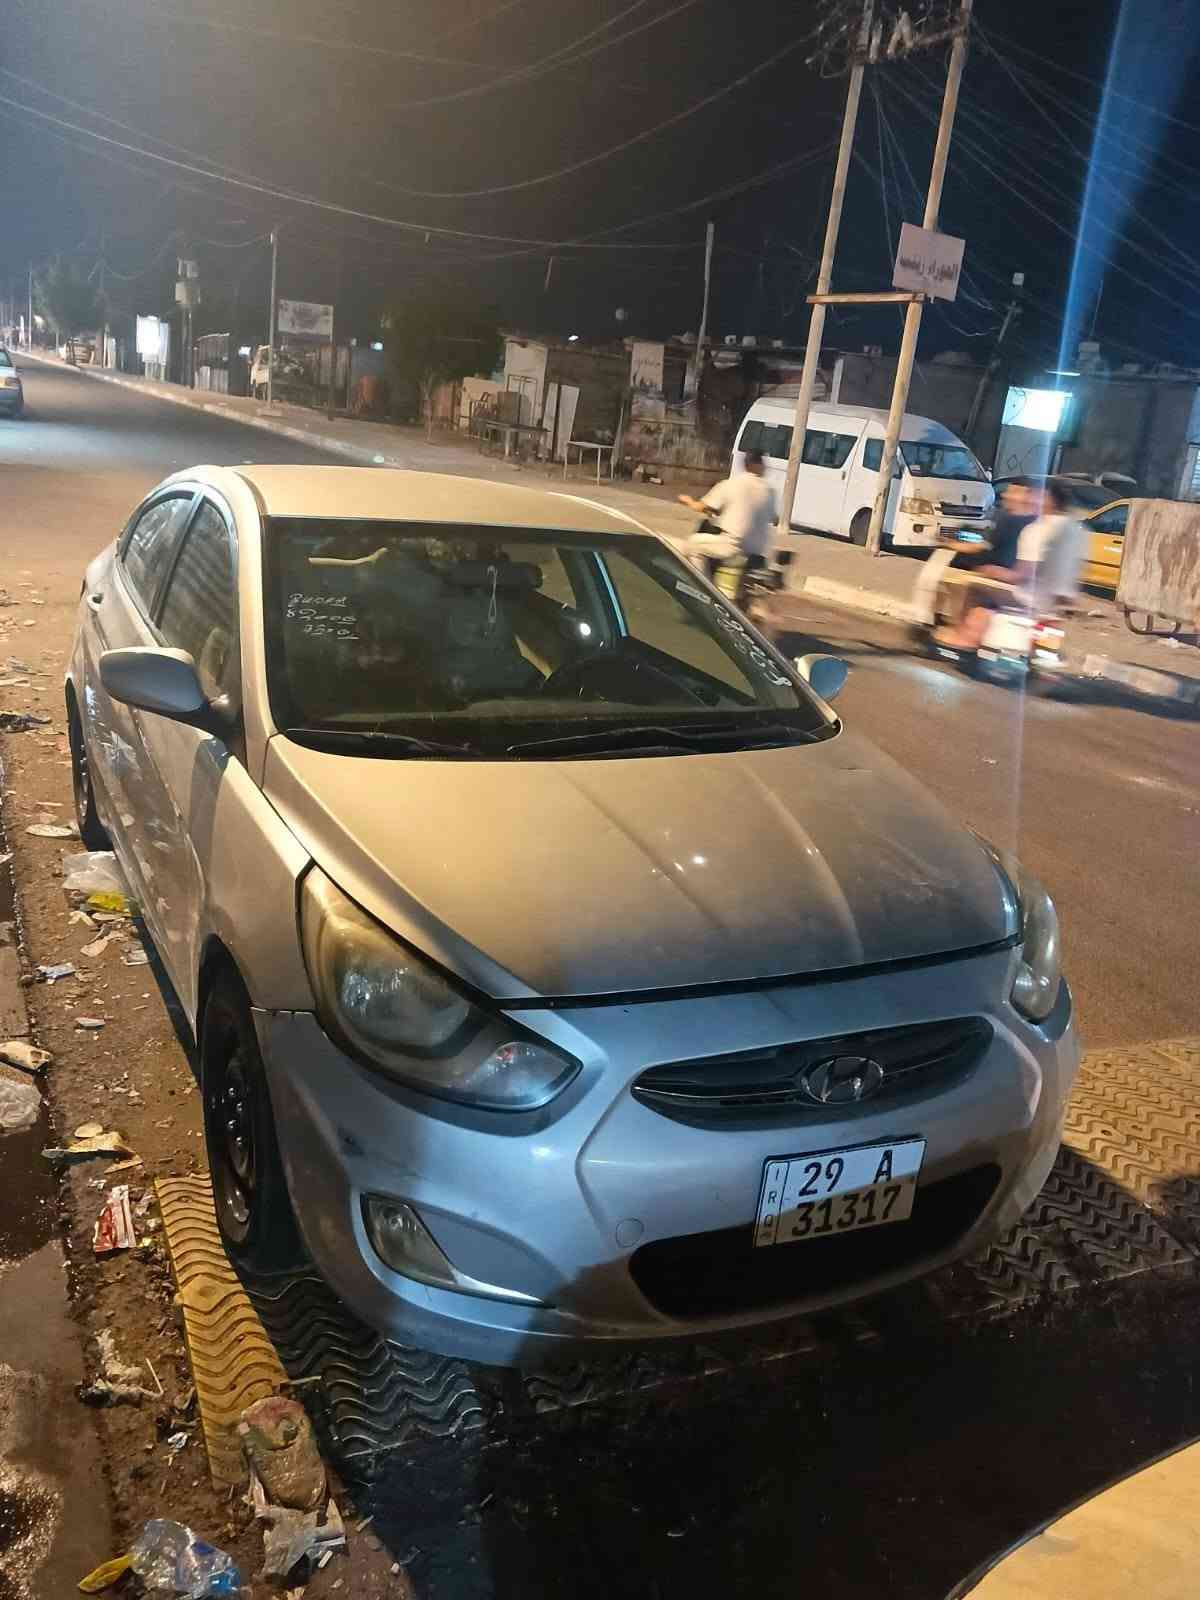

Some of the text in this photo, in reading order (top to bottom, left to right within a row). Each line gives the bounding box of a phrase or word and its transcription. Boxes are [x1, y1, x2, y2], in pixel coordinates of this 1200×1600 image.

[798, 1149, 893, 1197] 29 A
[791, 1184, 902, 1238] 31317
